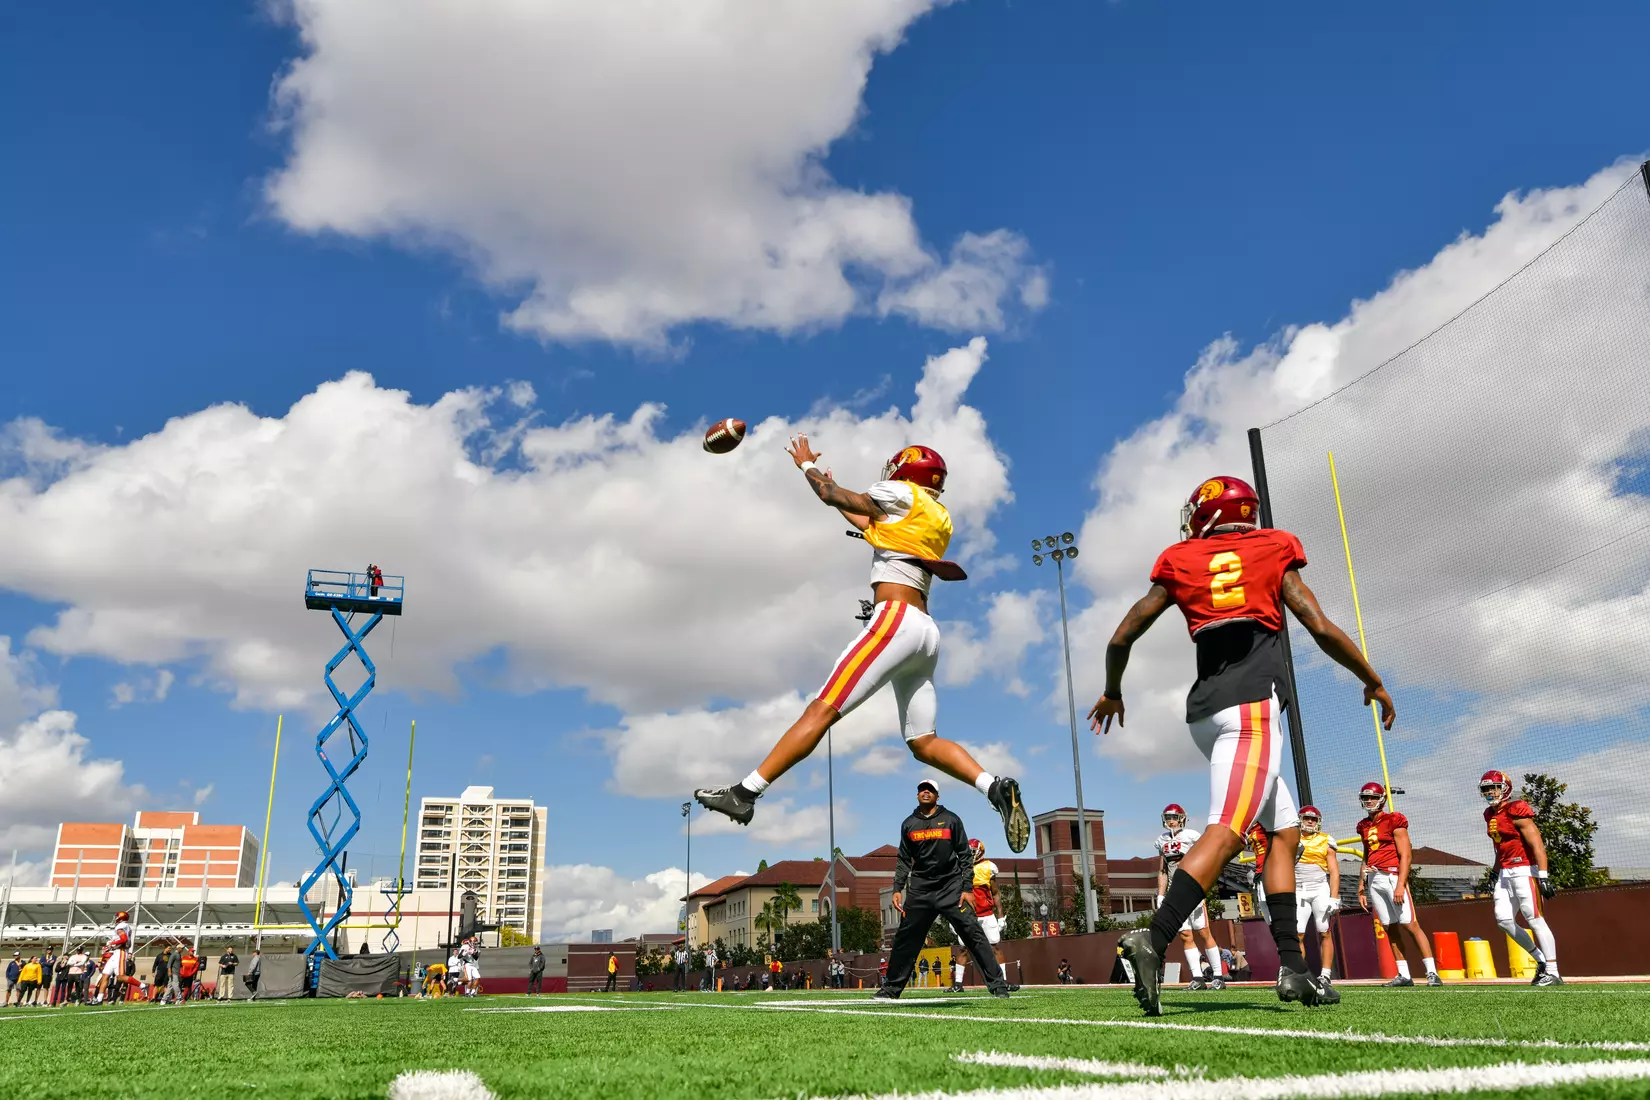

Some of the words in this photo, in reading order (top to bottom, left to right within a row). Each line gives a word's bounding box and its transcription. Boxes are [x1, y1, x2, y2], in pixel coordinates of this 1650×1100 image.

[1209, 552, 1245, 608] 2
[1241, 896, 1251, 911] SC
[1034, 923, 1040, 934] SC
[1050, 923, 1056, 934] SC
